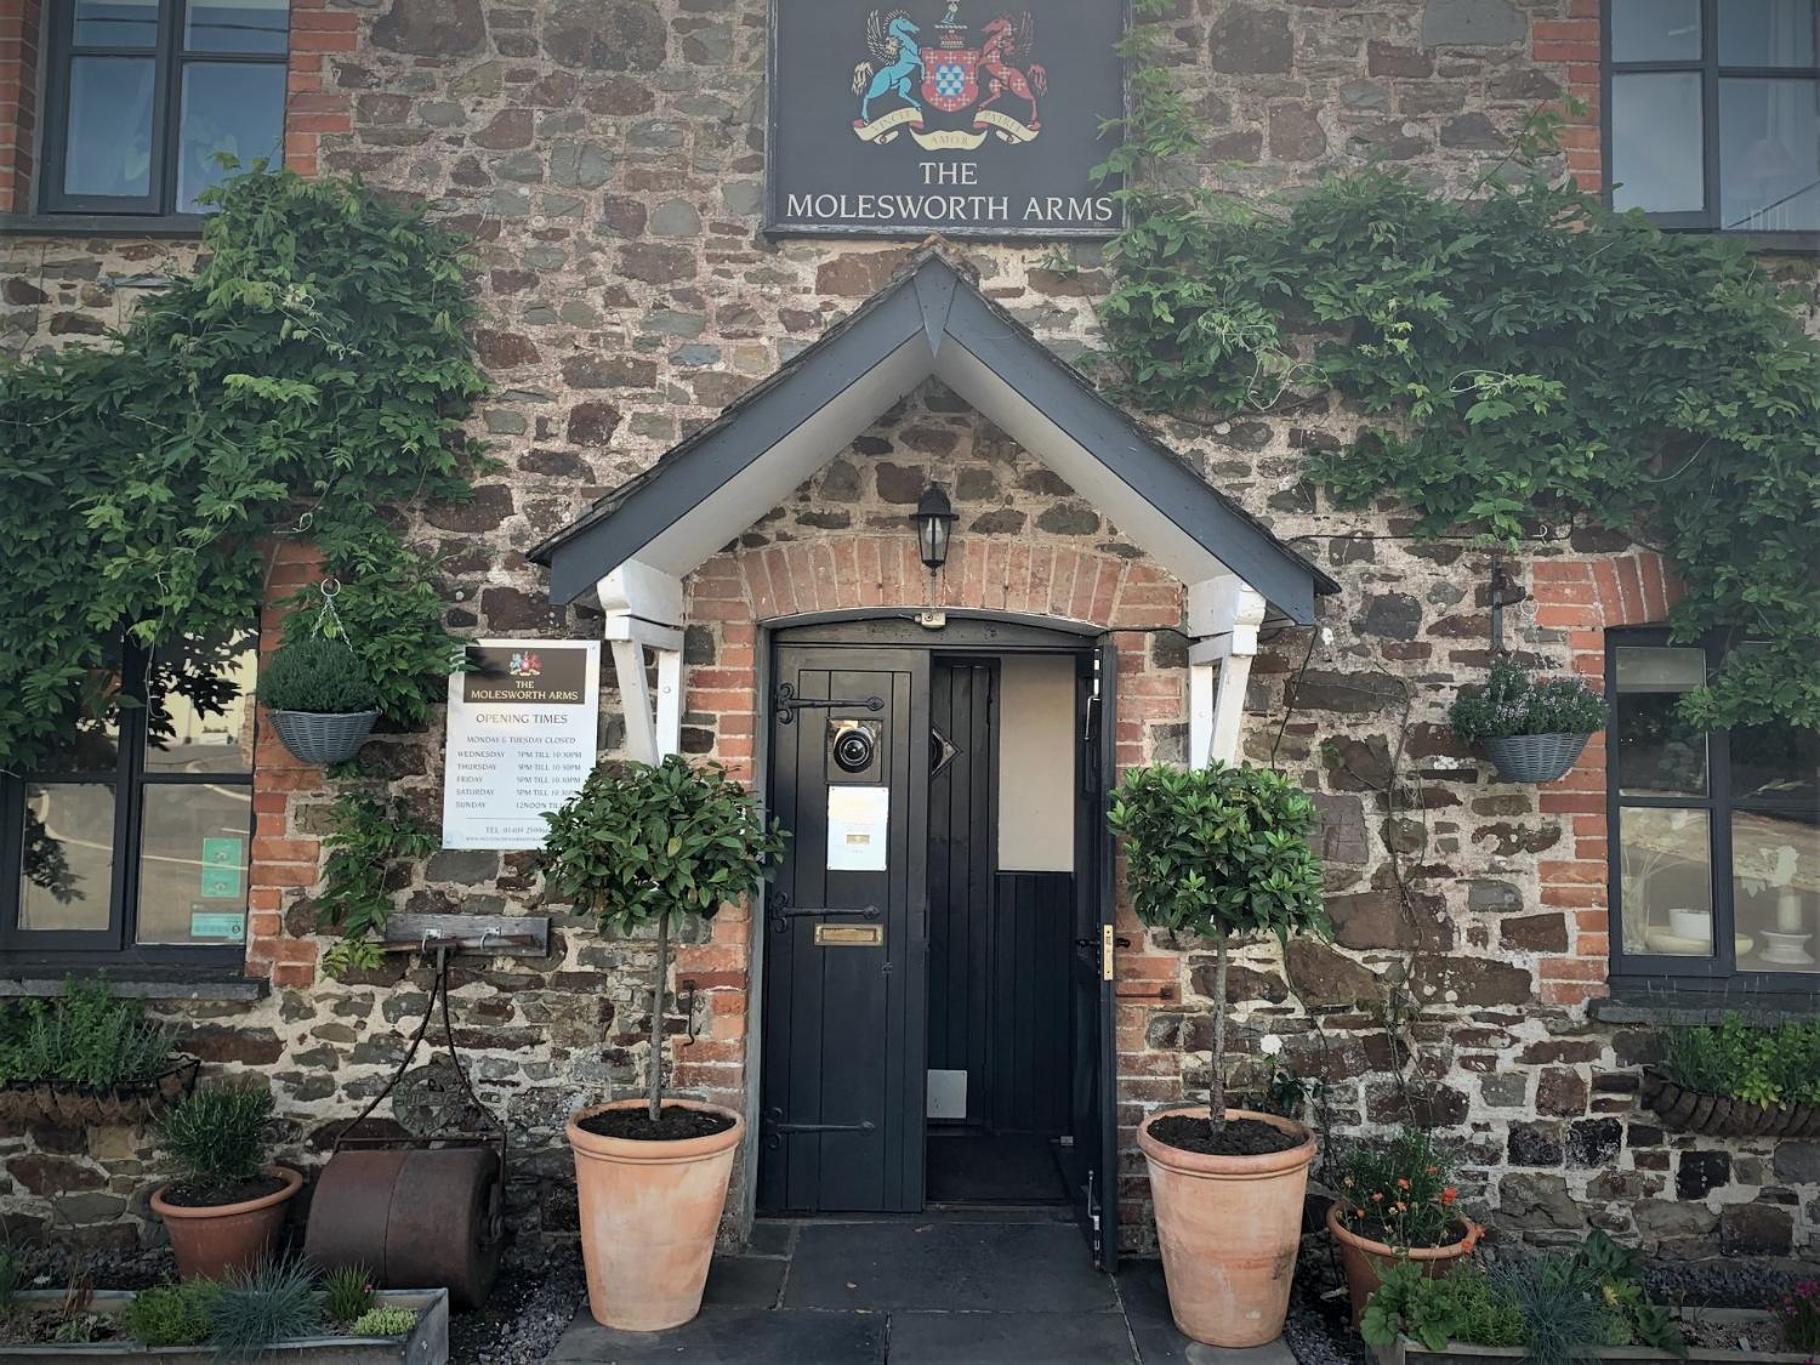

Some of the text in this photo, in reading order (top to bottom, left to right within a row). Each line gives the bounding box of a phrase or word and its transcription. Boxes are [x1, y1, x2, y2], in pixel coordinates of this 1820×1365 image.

[919, 162, 978, 185] THE
[786, 193, 1113, 222] MOLESWORTH ARMS
[515, 680, 535, 689] THE
[471, 690, 579, 701] MOLESWORTH ARMS
[476, 713, 568, 724] OPENING TIMES
[466, 736, 499, 744] MONDAY
[509, 736, 542, 744] TUESDAY
[545, 737, 576, 745] CLOSED
[457, 763, 497, 771] THURSDAY
[455, 801, 486, 809] SUNDAY
